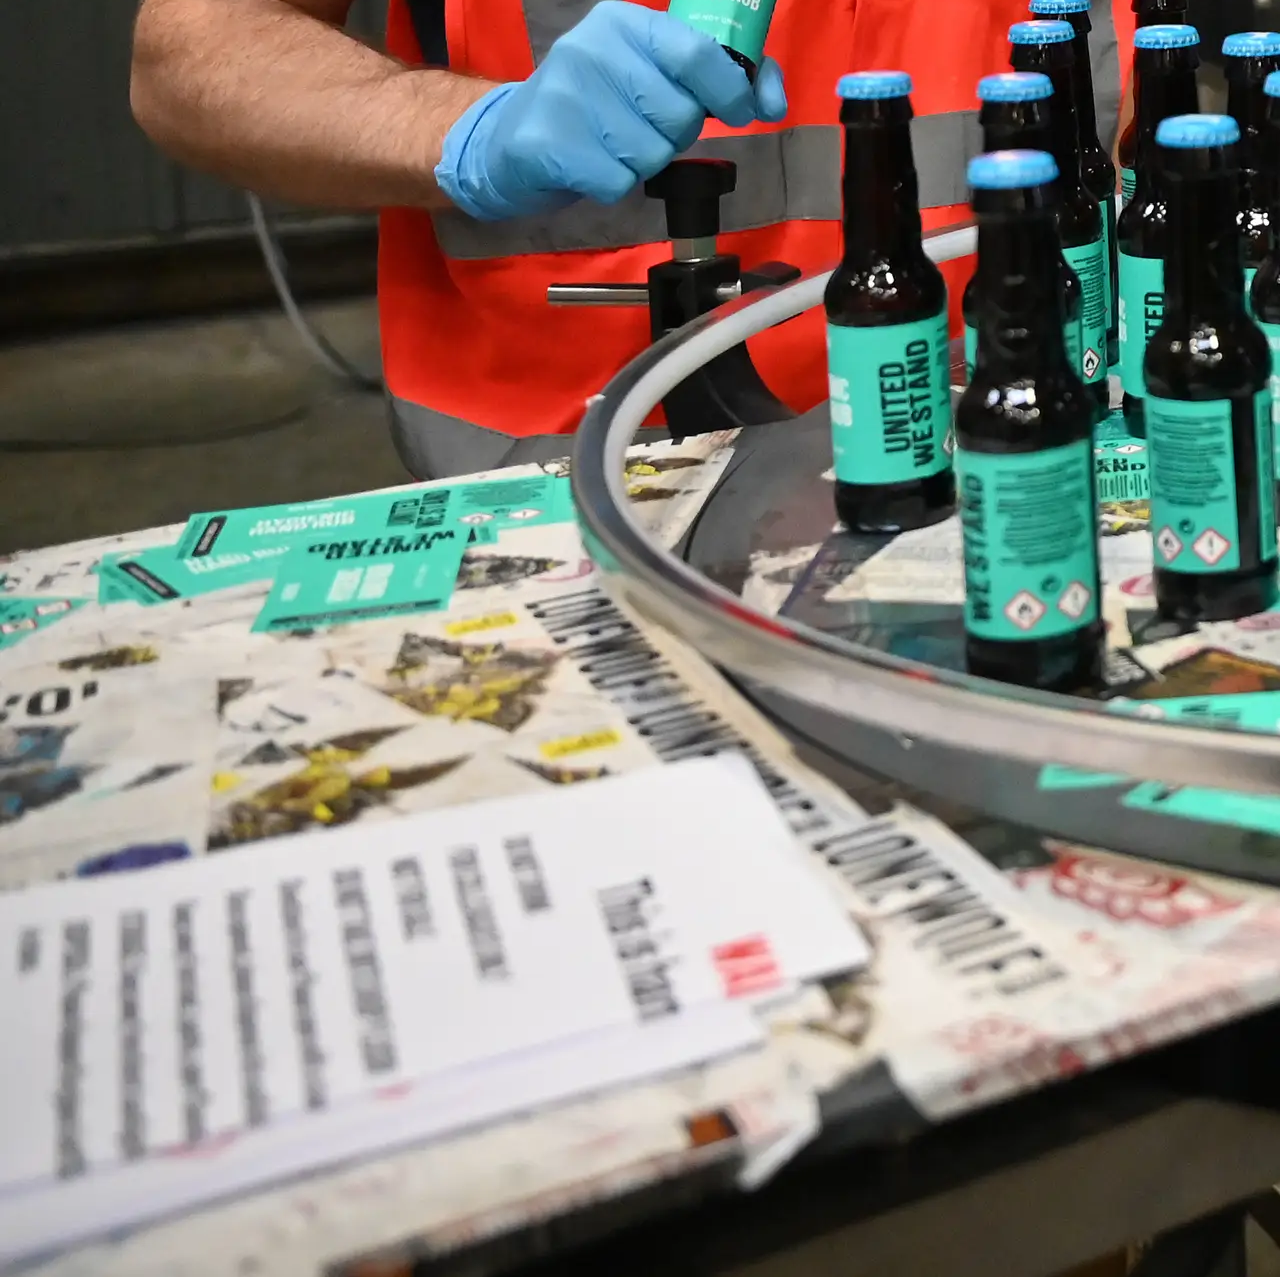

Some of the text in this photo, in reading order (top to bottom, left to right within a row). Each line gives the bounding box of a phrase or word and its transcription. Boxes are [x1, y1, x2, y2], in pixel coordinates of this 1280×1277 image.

[879, 361, 911, 454] UNITED
[905, 339, 935, 468] WE STAND
